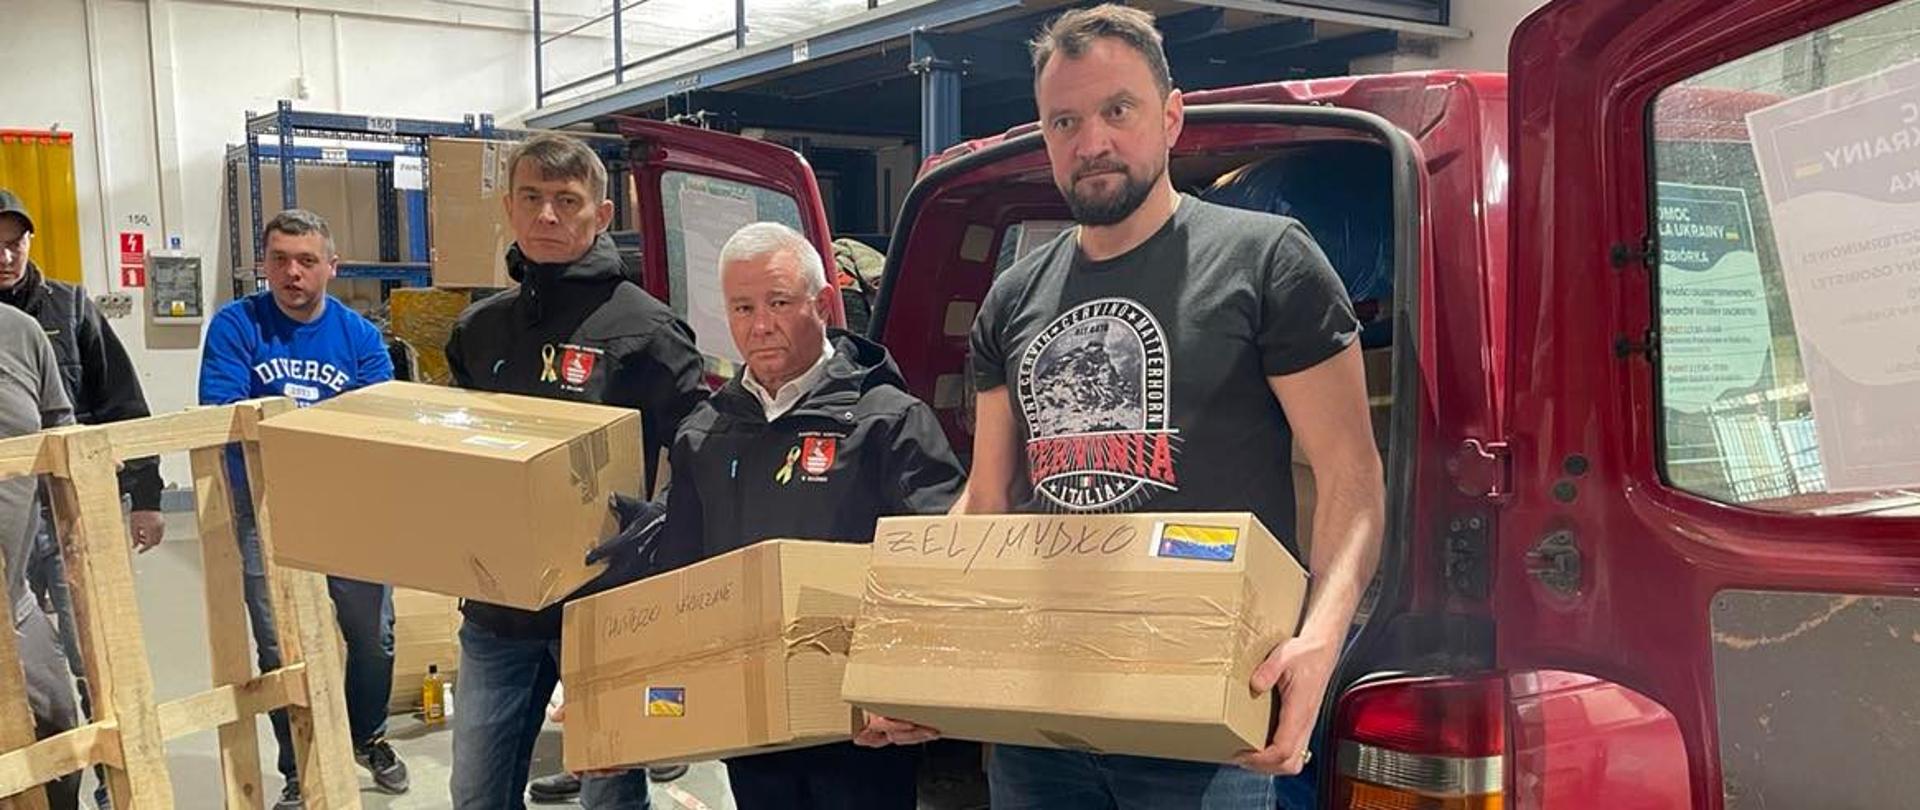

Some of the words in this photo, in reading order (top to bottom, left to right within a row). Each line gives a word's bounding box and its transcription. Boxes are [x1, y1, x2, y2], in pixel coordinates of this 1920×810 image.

[253, 358, 350, 392] DIVERSE
[1062, 302, 1130, 328] CERVINO
[1134, 315, 1164, 423] MATTERHORN
[1060, 483, 1116, 505] ITALIA
